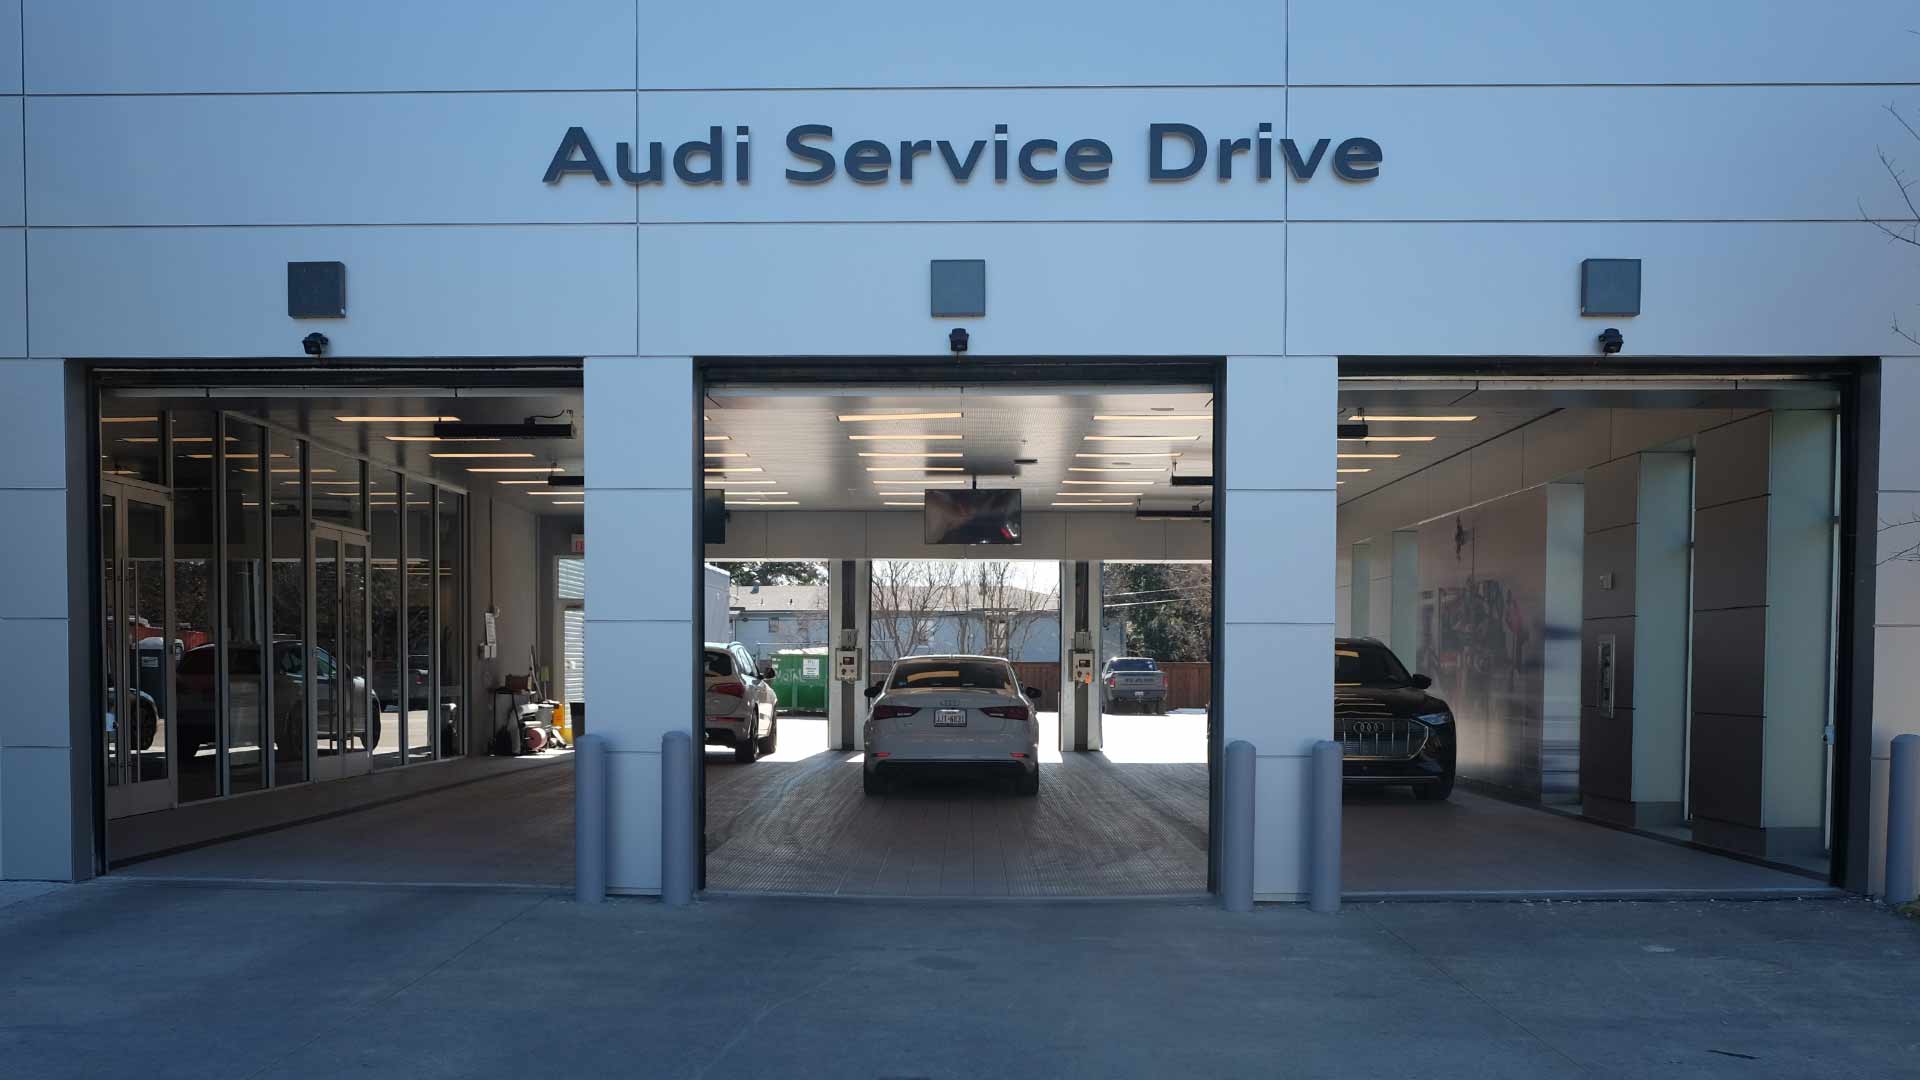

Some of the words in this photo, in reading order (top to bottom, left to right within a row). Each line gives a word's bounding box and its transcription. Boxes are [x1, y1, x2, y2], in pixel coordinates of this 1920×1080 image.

[543, 125, 749, 187] Audi
[785, 124, 1112, 187] Service
[1150, 122, 1383, 185] Drive
